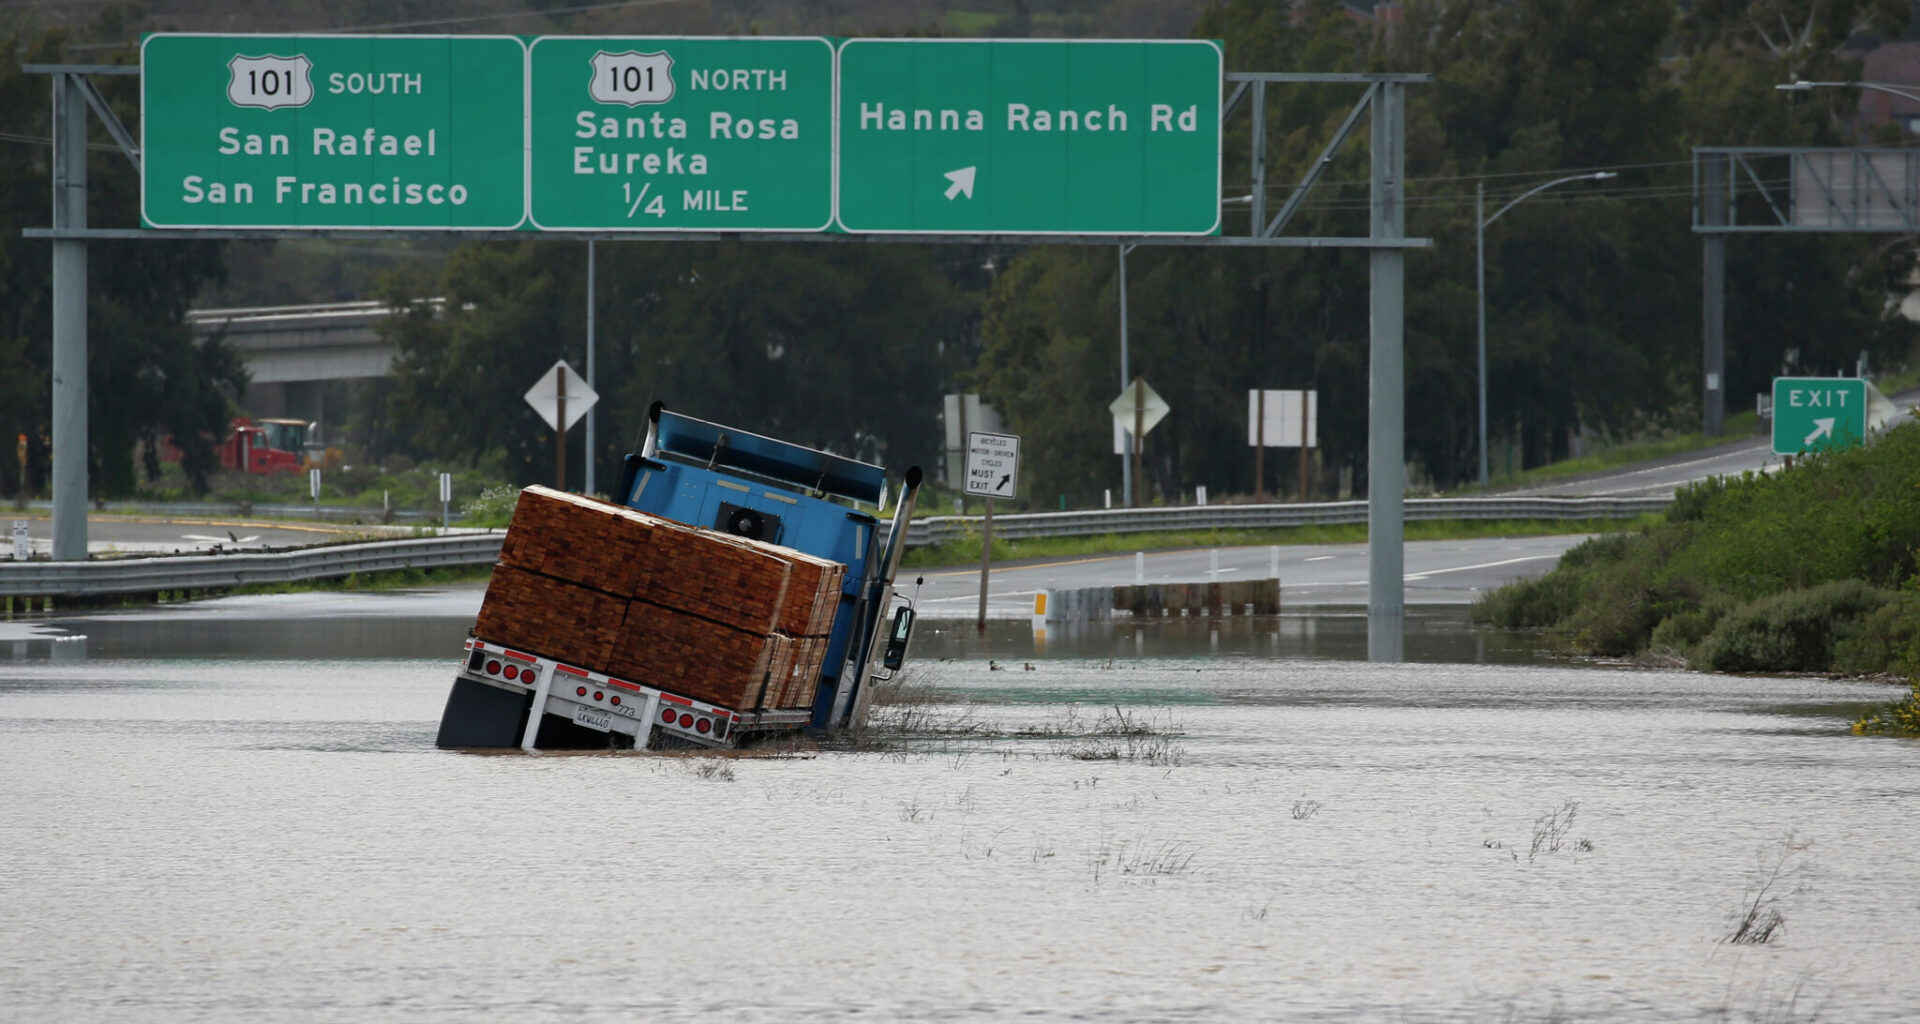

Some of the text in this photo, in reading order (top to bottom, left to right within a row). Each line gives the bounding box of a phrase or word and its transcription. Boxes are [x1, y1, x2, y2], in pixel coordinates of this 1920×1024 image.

[249, 70, 422, 95] 101 SOUTH
[611, 67, 787, 92] 101 NORTH
[575, 111, 799, 140] Santa Rosa
[860, 103, 1197, 132] Hanna Ranch Rd
[219, 127, 436, 156] San Rafael
[574, 147, 708, 175] Eureka
[183, 176, 468, 205] San Francisco
[623, 182, 749, 219] 1/4 MILE
[1789, 390, 1849, 407] EXIT
[980, 438, 1007, 446] BICYCLES
[971, 469, 995, 478] MUST
[981, 459, 1003, 467] CYCLES
[970, 481, 988, 490] EXIT
[619, 705, 635, 716] 773
